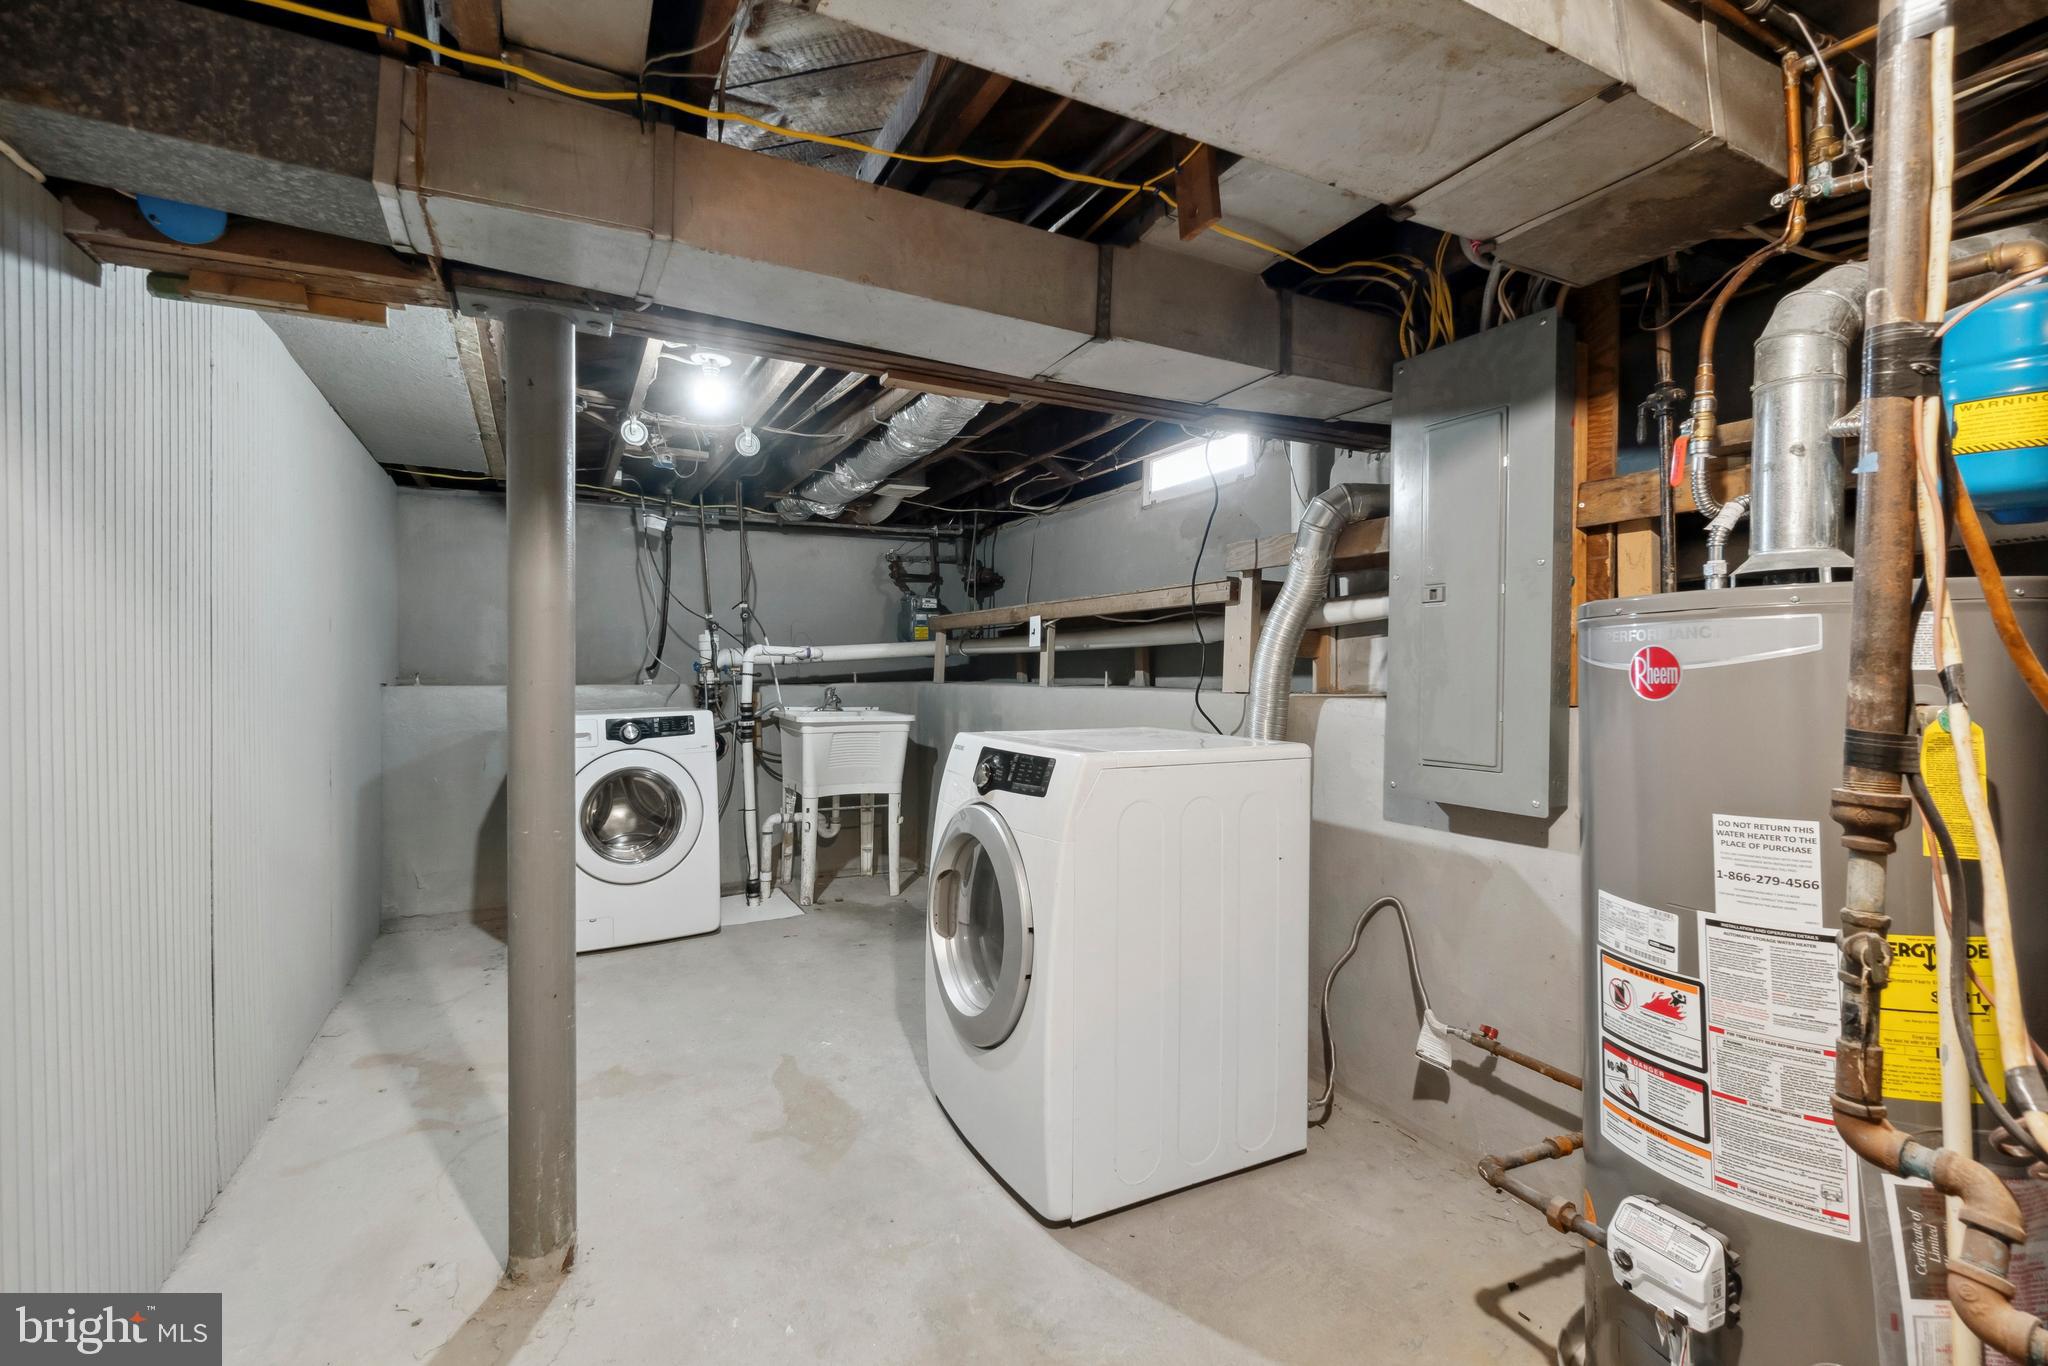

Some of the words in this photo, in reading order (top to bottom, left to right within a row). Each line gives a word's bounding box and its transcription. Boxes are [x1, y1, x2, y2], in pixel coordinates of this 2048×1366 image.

[1634, 648, 1678, 692] Rheem
[1716, 829, 1745, 839] WATER
[1747, 833, 1781, 842] HEATER
[1784, 835, 1796, 844] TO
[1799, 836, 1817, 845] THE
[1718, 820, 1731, 828] DO
[1733, 822, 1751, 830] NOT
[1754, 823, 1791, 833] RETURN
[1793, 826, 1814, 834] THIS
[1721, 839, 1746, 849] PLACE
[1749, 842, 1761, 850] OF
[1763, 844, 1812, 855] PURCHASE
[1716, 869, 1820, 891] 1-866-279-4566
[1633, 1058, 1665, 1078] DANGER
[1910, 1213, 1927, 1276] Certificate
